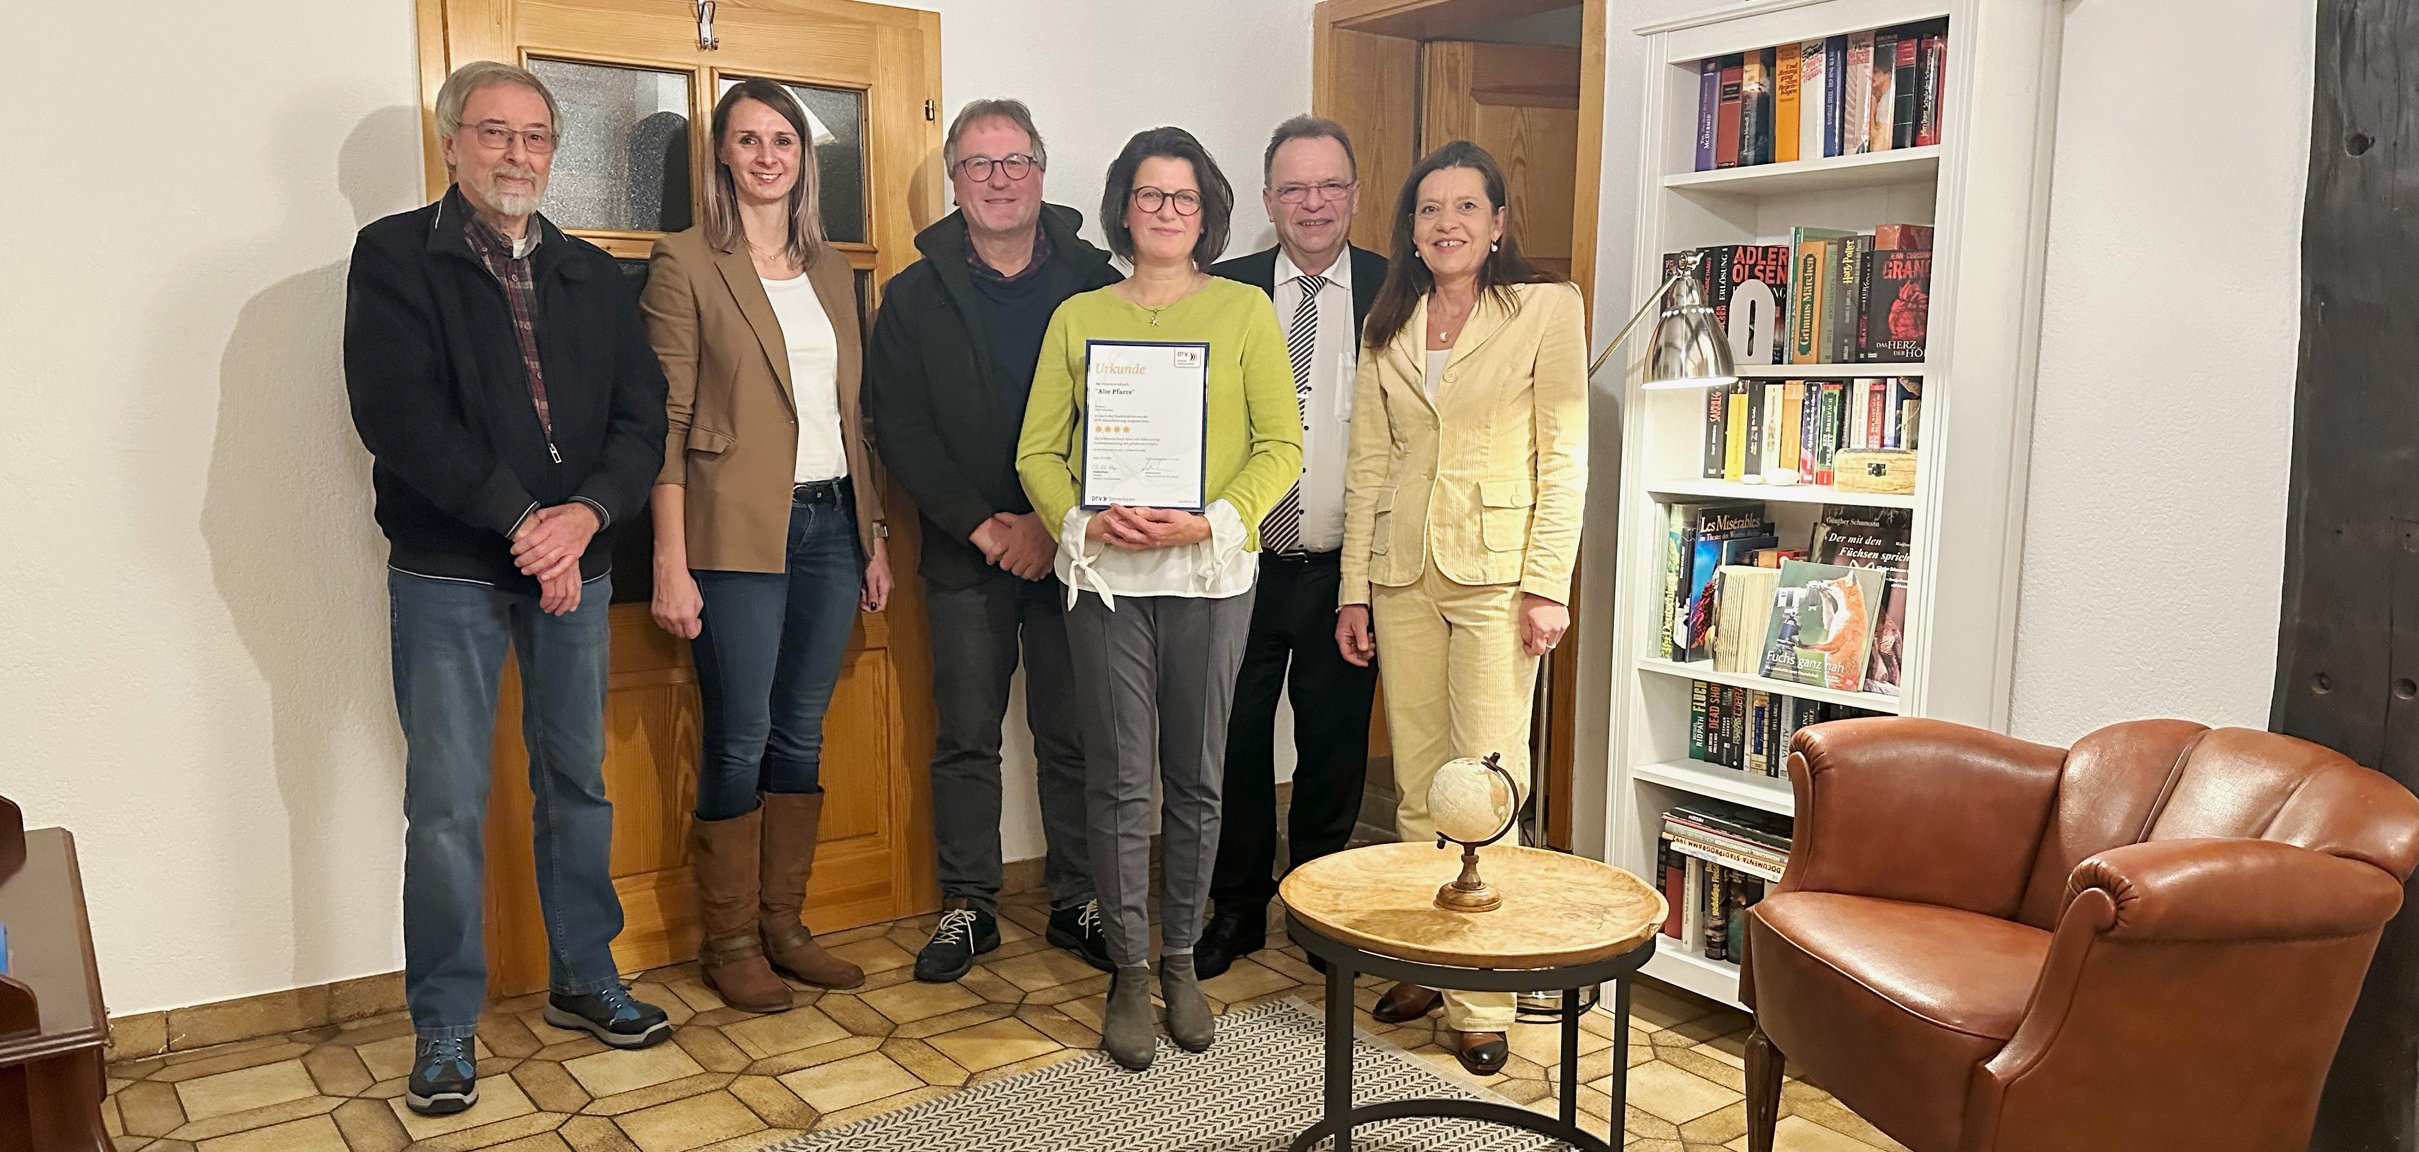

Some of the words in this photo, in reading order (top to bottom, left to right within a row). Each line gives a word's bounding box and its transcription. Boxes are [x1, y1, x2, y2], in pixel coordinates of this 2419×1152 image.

[1733, 246, 1789, 266] ADLER
[1844, 240, 1855, 263] Potter
[1719, 254, 1728, 300] ERLÖSUNG
[1732, 264, 1788, 284] OLSEN
[1803, 257, 1814, 301] Märchen
[1842, 263, 1853, 285] Harry
[1800, 304, 1811, 345] Grimms
[1887, 341, 1918, 350] HERZ
[1096, 363, 1146, 375] Urkunde
[1710, 392, 1722, 422] SAKRILEG
[1825, 398, 1833, 432] DREIFACH
[1700, 517, 1715, 533] Les
[1716, 512, 1760, 532] Misérables
[1850, 519, 1880, 527] Schumann
[1829, 533, 1846, 542] Der
[1848, 535, 1863, 544] mit
[1865, 536, 1882, 546] den
[1839, 546, 1879, 559] Füchsen
[1767, 650, 1796, 665] Fuchs
[1797, 658, 1822, 669] ganz
[1826, 662, 1844, 673] nah
[1733, 687, 1743, 716] COBRA
[1709, 706, 1719, 729] DEAD
[1696, 716, 1704, 747] RIDPATH
[1781, 728, 1789, 758] ALPHA
[1712, 864, 1720, 883] Fleisc
[1742, 857, 1781, 874] DOCUMENTA
[1711, 884, 1720, 916] geduldige
